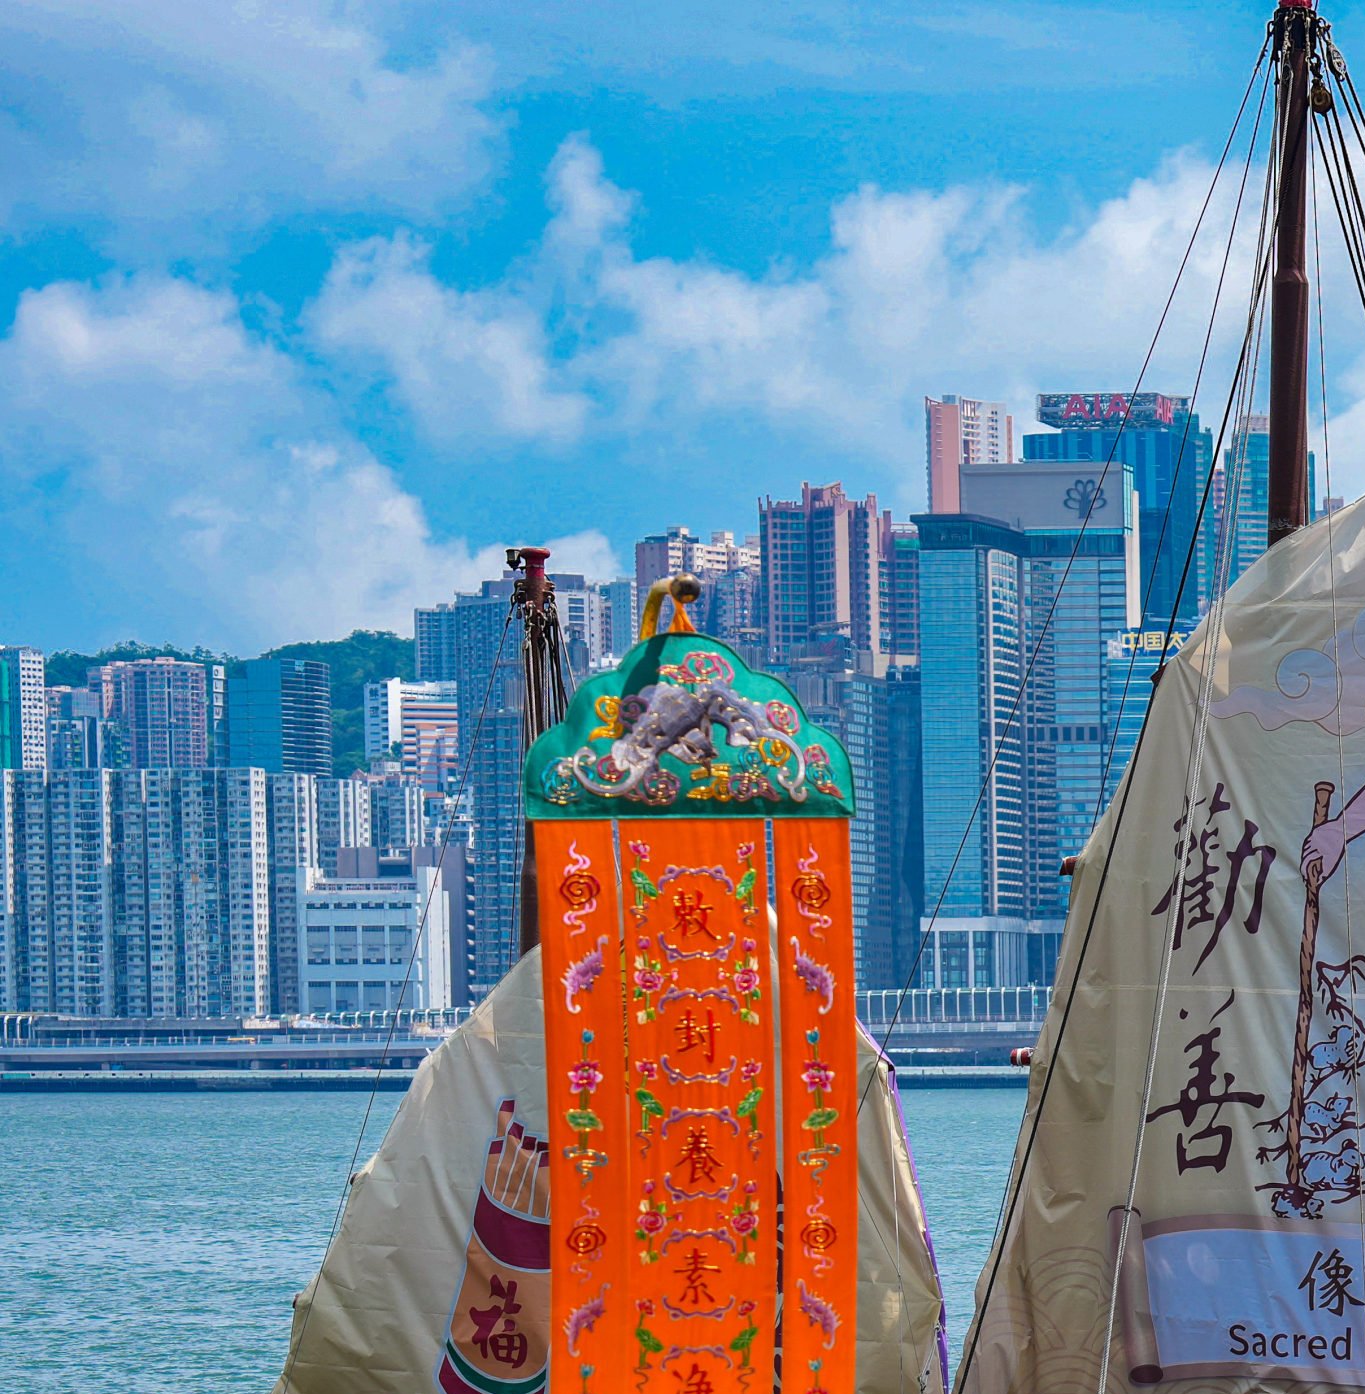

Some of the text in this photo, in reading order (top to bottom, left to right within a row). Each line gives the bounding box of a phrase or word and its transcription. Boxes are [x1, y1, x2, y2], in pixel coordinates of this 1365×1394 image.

[1062, 393, 1134, 419] AIA
[1122, 631, 1195, 651] 中国太
[1146, 782, 1276, 1176] 勸善
[469, 1274, 528, 1369] 福
[1229, 1324, 1351, 1361] Sacred
